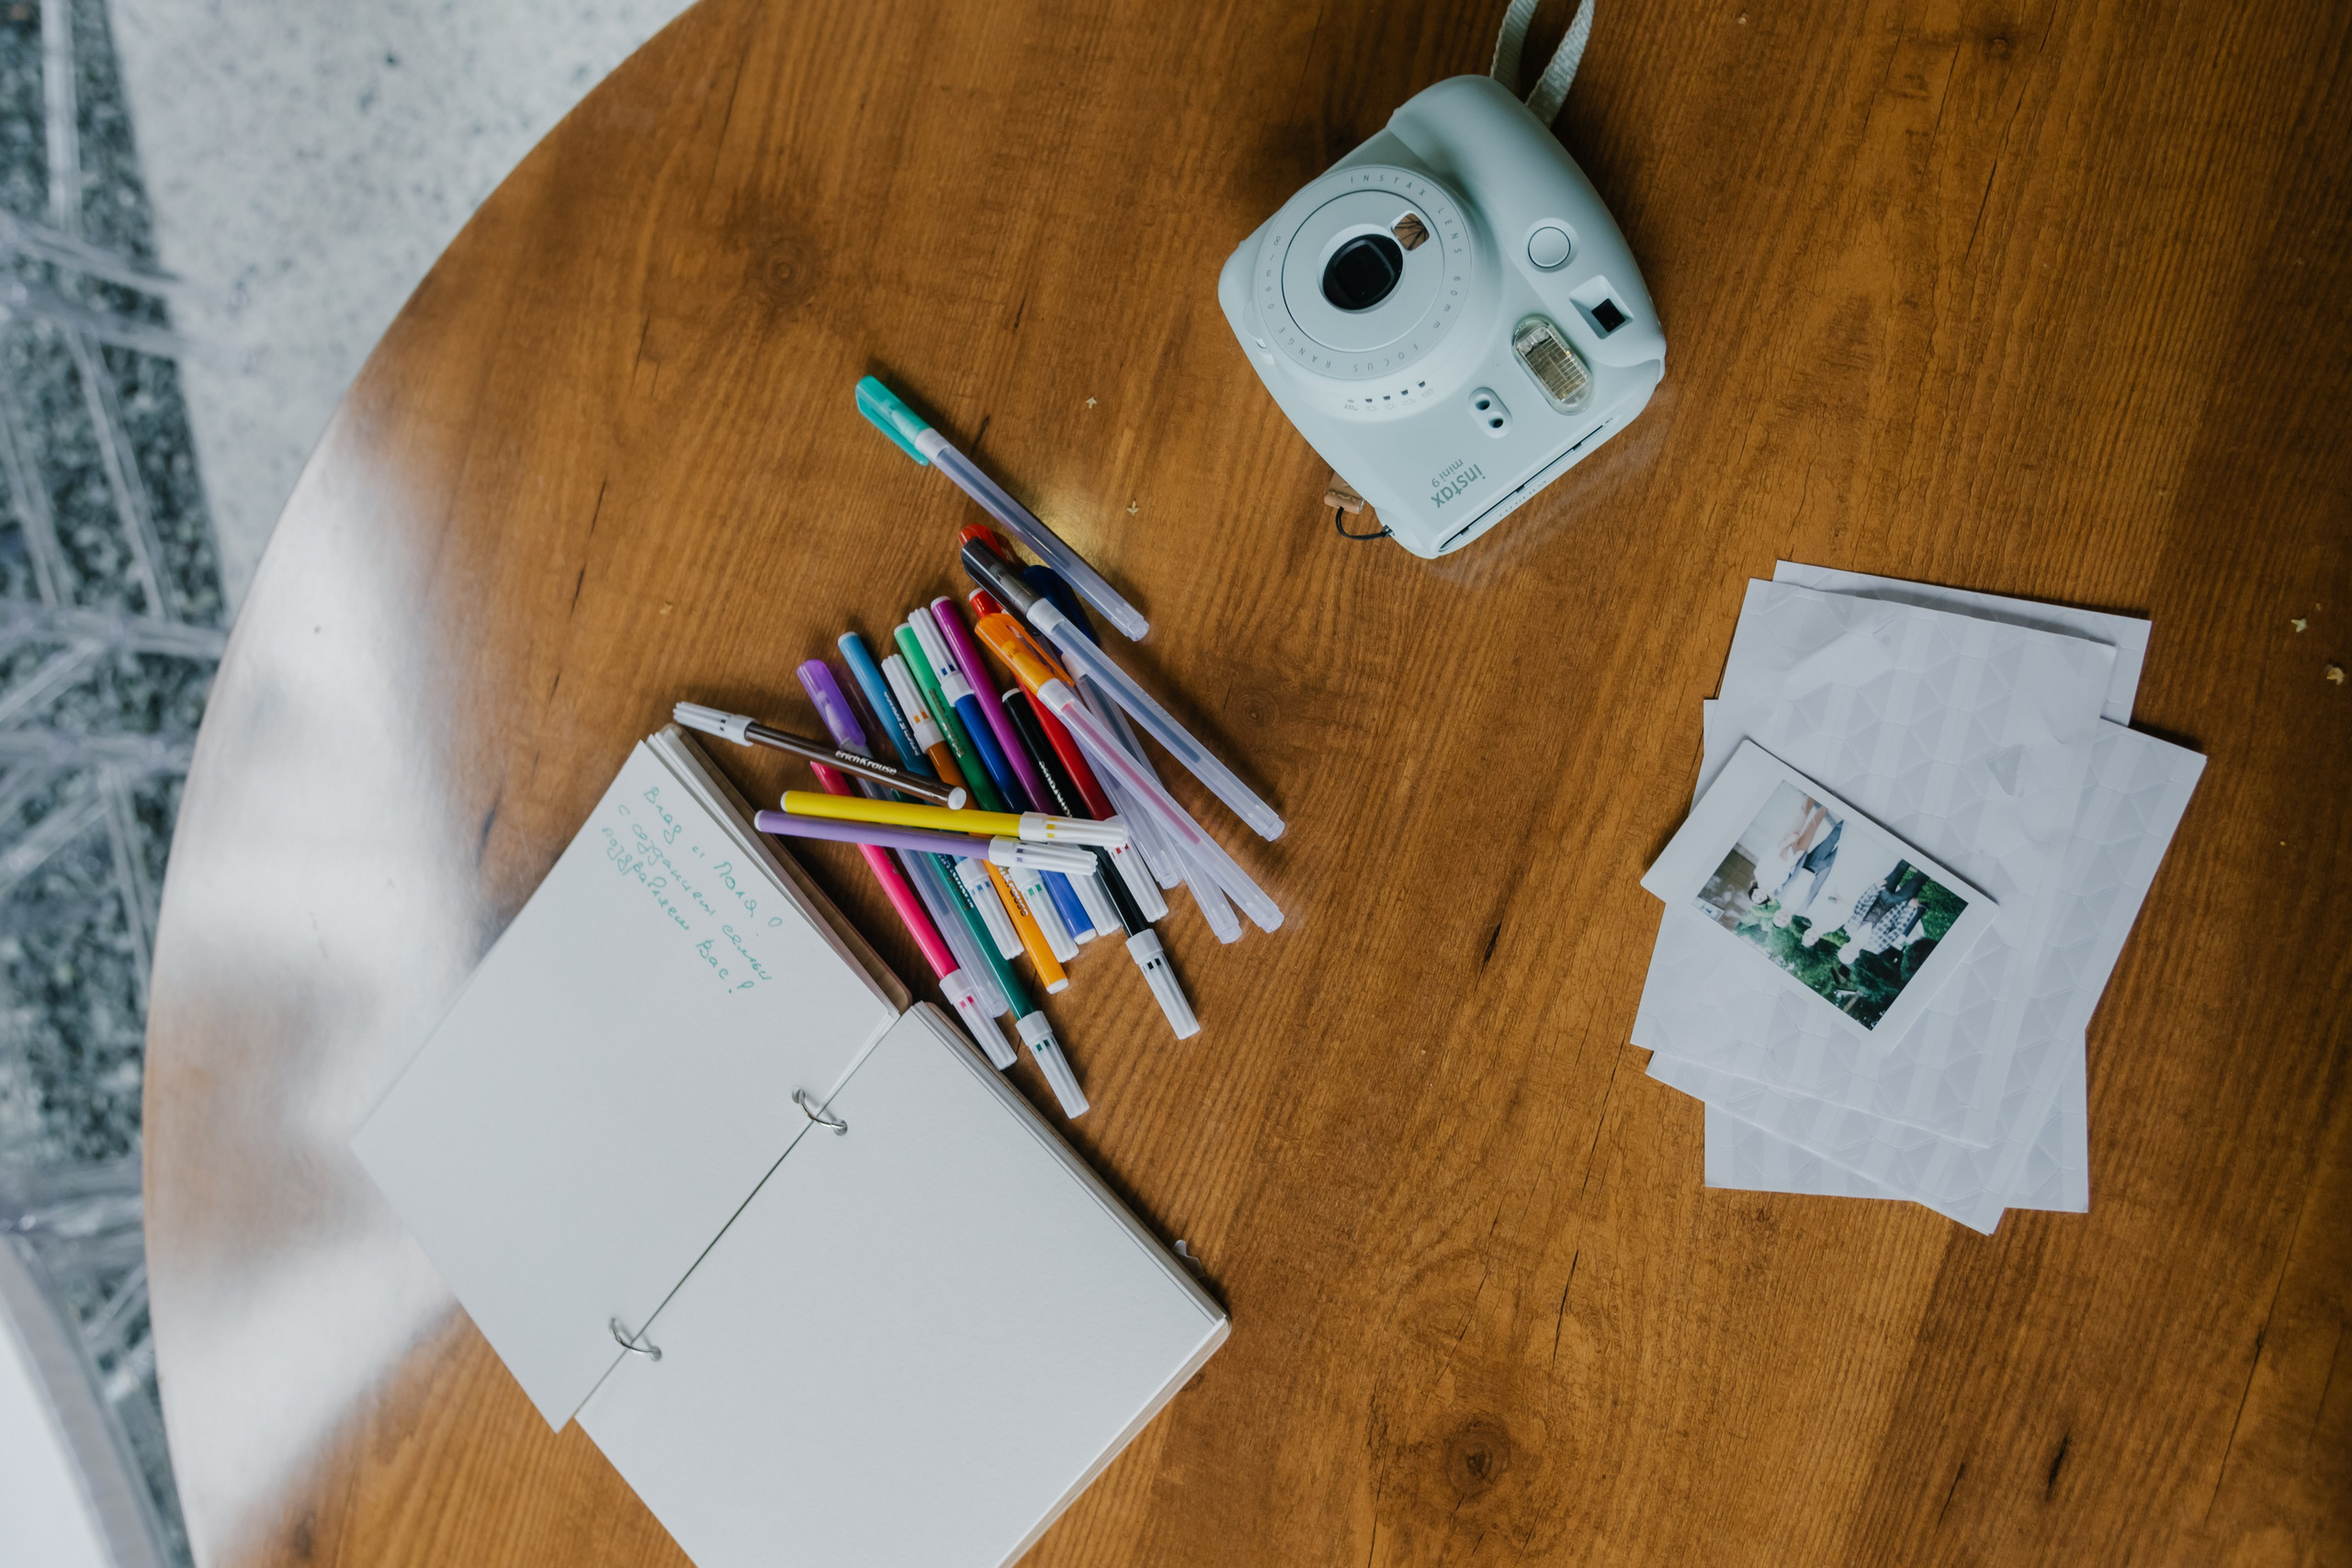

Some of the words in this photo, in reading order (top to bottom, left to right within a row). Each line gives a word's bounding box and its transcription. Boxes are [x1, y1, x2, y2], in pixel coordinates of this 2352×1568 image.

[1351, 173, 1427, 197] INSTAX
[1437, 207, 1463, 254] LENS
[1433, 276, 1461, 329] 60mm
[1278, 326, 1332, 368] RANGE
[1354, 343, 1419, 372] FOCUS
[1430, 464, 1486, 508] instax
[1431, 478, 1441, 488] 9
[1439, 458, 1464, 482] mini
[643, 786, 682, 844] Влад
[602, 828, 689, 931] поздравляем
